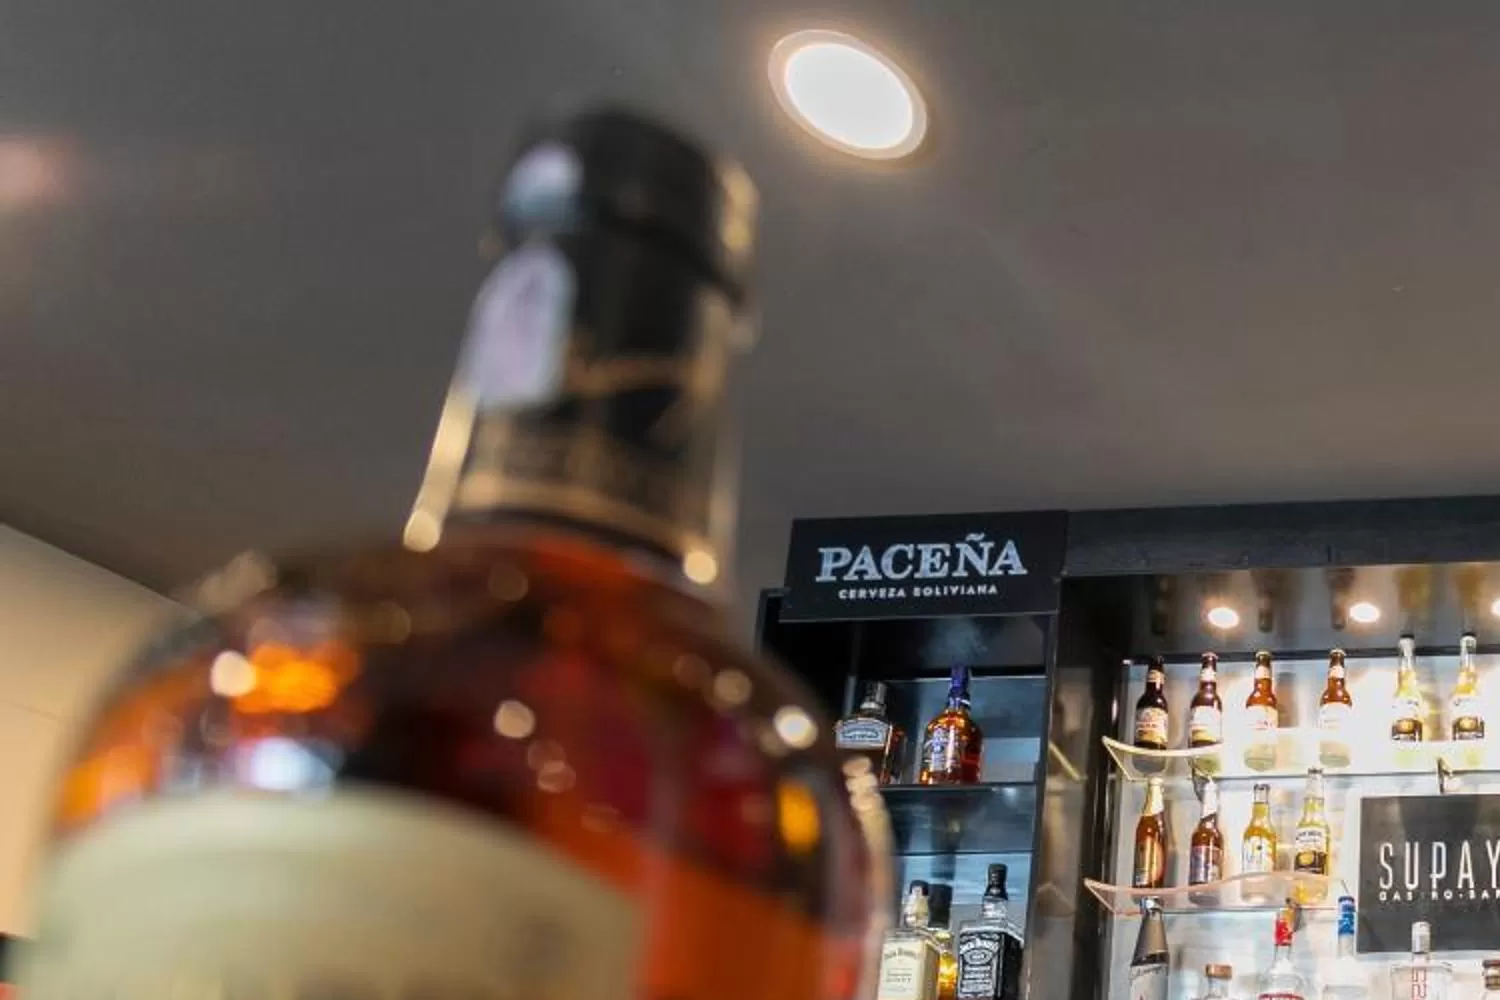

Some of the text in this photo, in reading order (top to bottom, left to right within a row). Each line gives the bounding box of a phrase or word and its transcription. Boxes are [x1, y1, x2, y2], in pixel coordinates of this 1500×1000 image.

[815, 532, 1028, 582] PACEÑA
[838, 584, 998, 600] CERVEZA BOLIVIANA
